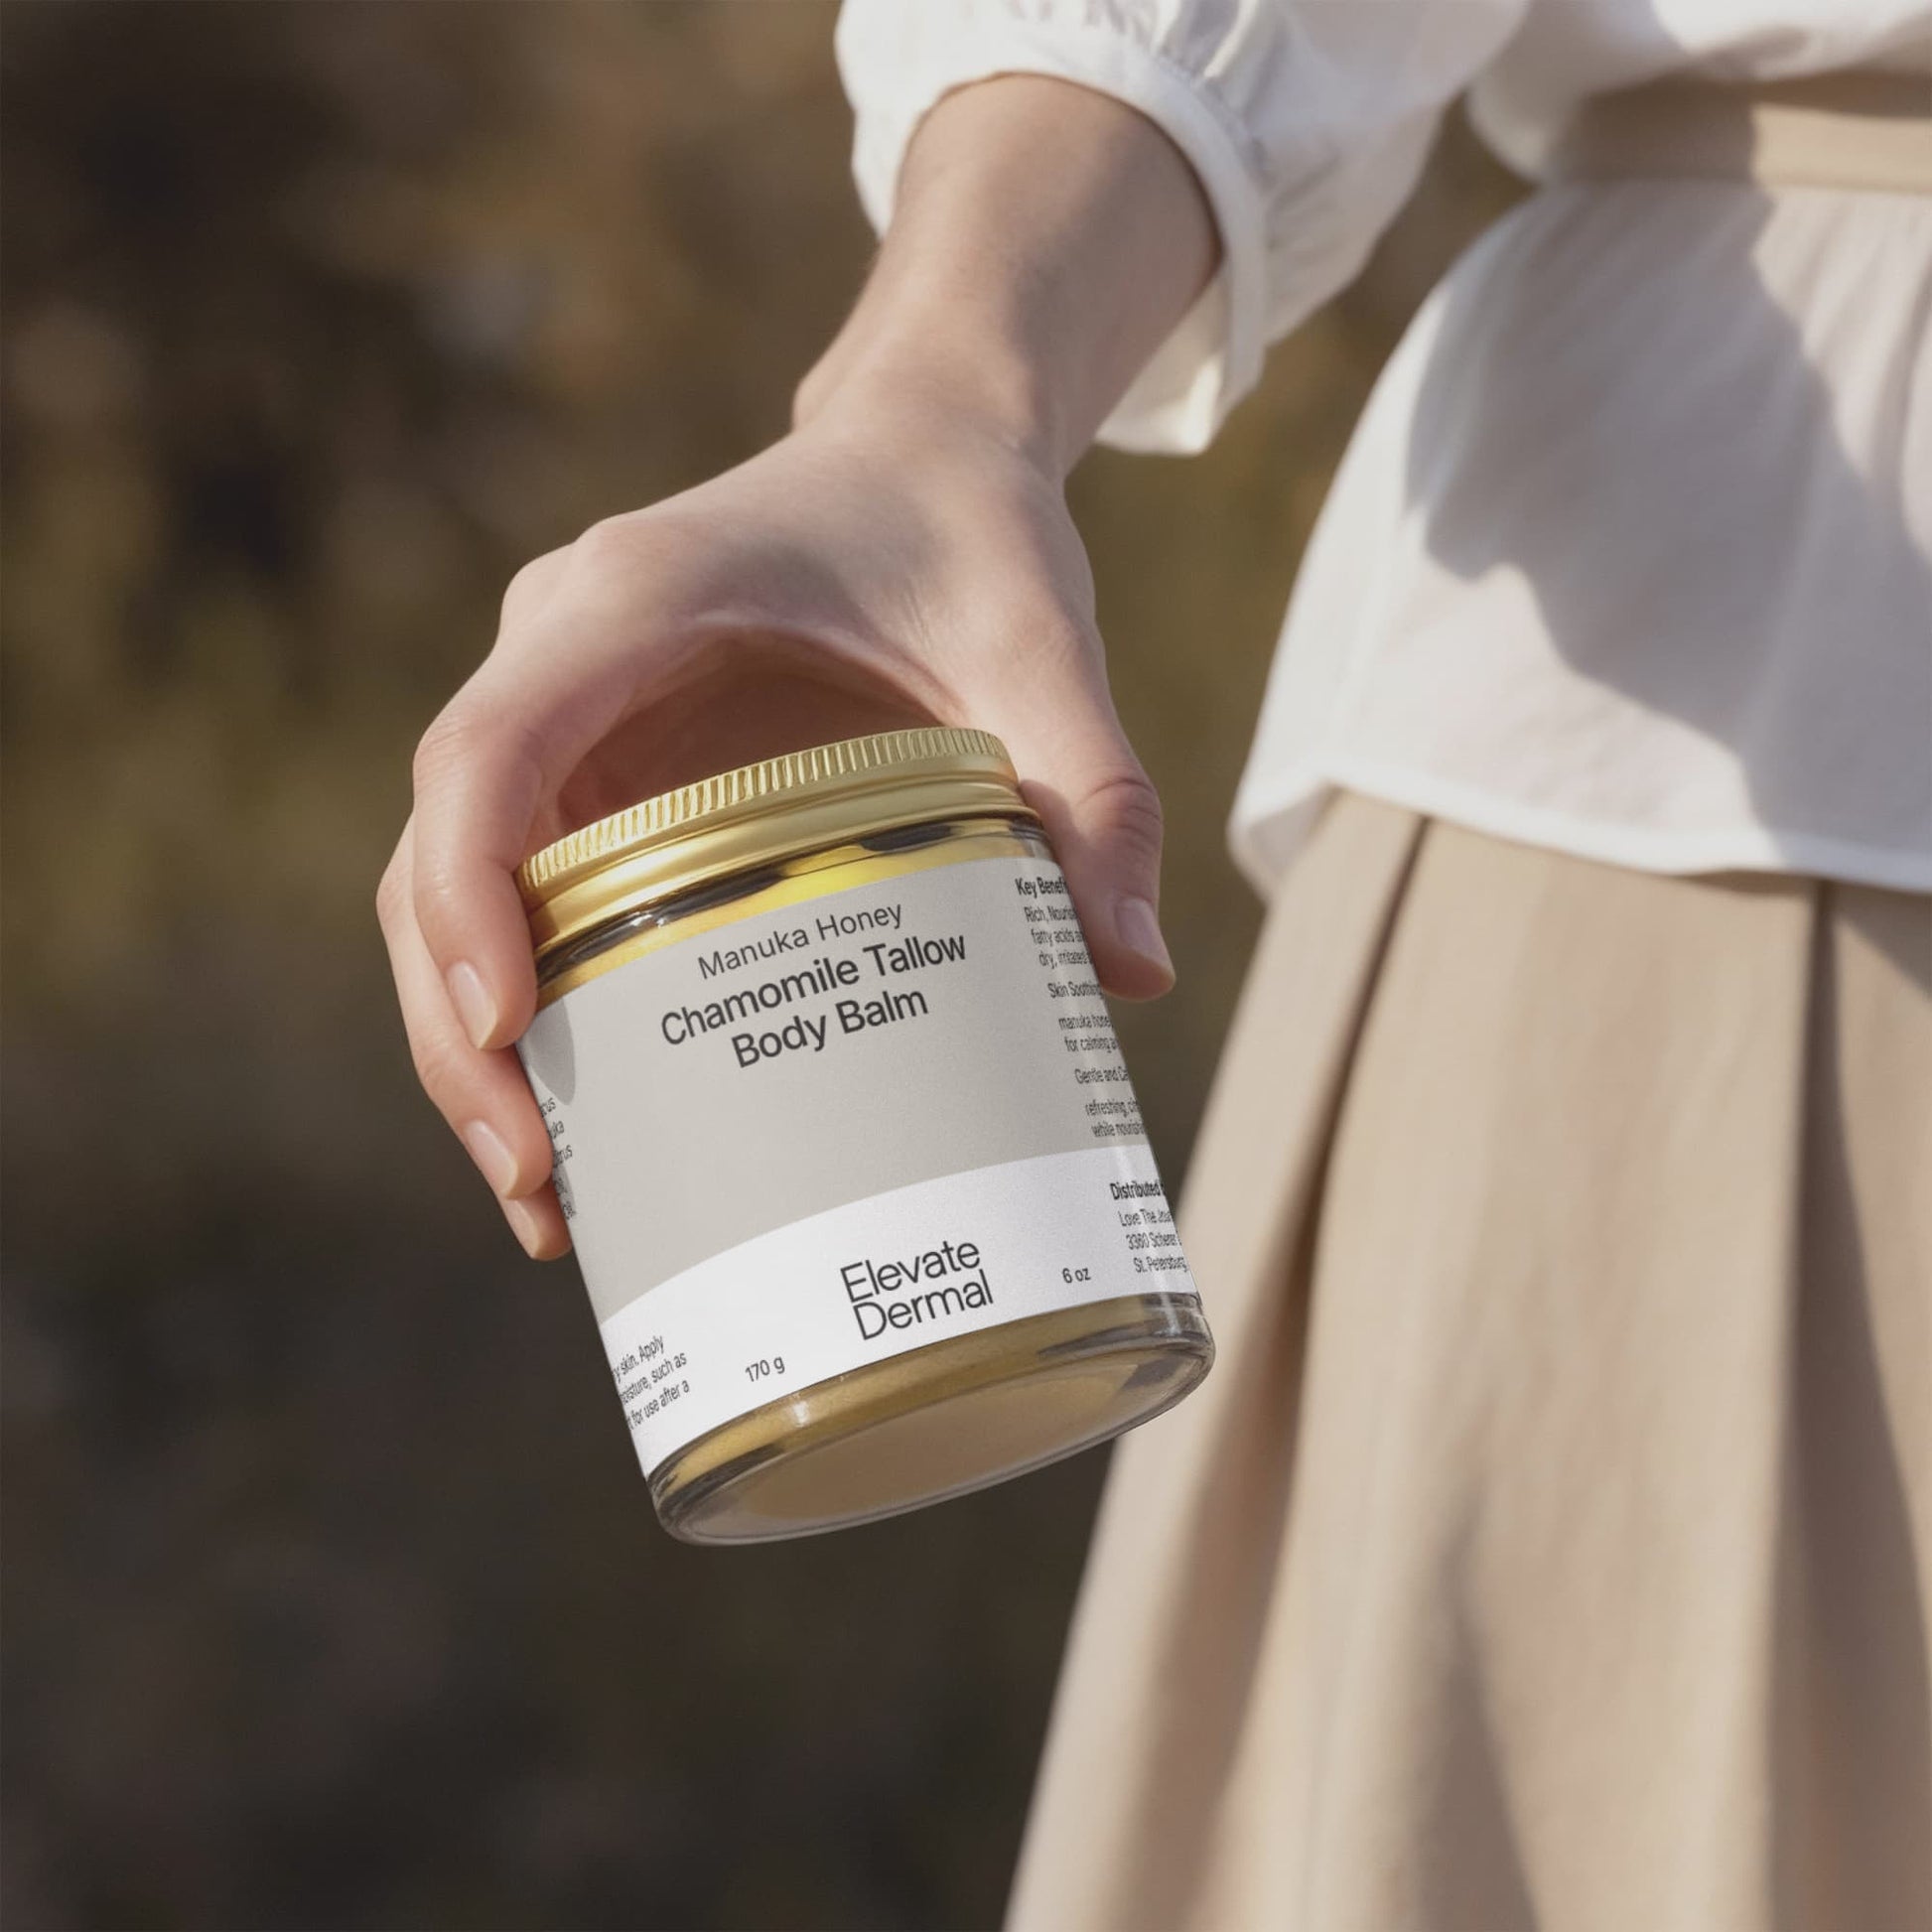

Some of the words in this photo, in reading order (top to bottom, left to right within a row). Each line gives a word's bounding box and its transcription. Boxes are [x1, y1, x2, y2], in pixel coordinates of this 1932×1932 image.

[1015, 878, 1037, 898] Key
[698, 927, 809, 980] Manuka
[816, 904, 901, 940] Honey
[661, 958, 860, 1044] Chamomile
[863, 935, 967, 976] Tallow
[1048, 982, 1069, 998] Skin
[731, 1015, 827, 1068] Body
[835, 991, 928, 1034] Balm
[1064, 1036, 1078, 1052] for
[1110, 1178, 1162, 1200] Distributed
[1118, 1210, 1142, 1227] Love
[840, 1241, 980, 1303] Elevate
[1062, 1268, 1073, 1284] 6
[1075, 1267, 1091, 1282] oz
[853, 1268, 994, 1340] Dermal
[638, 1335, 664, 1364] Apply
[651, 1363, 673, 1384] such
[673, 1352, 687, 1369] as
[745, 1359, 770, 1382] 170
[774, 1356, 785, 1374] g
[631, 1405, 644, 1426] for
[643, 1395, 660, 1418] use
[660, 1383, 681, 1408] after
[682, 1380, 690, 1393] a
